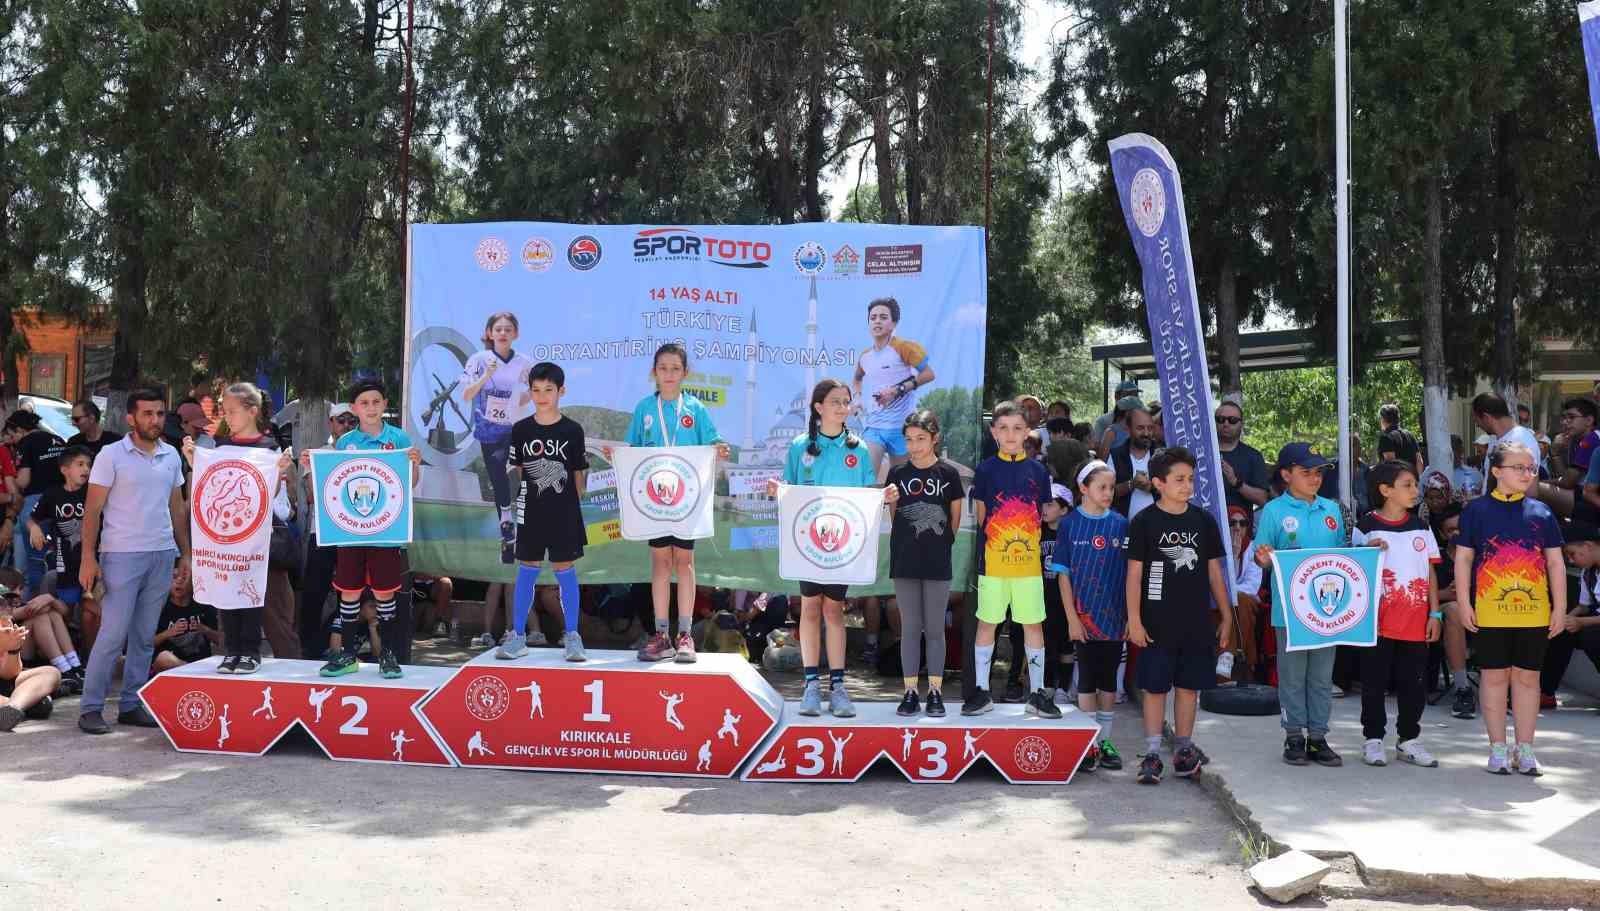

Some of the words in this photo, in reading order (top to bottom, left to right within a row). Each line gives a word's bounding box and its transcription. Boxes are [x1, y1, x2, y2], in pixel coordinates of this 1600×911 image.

[649, 288, 665, 300] 14
[671, 287, 700, 304] YAŞ
[704, 290, 738, 304] ALTI
[642, 309, 743, 334] TÜRKİYE
[695, 342, 856, 366] ŞAMPİYONASI
[492, 408, 506, 419] 26
[583, 679, 611, 723] 1
[339, 696, 369, 736] 2
[560, 730, 631, 744] KIRIKKALE
[504, 744, 552, 757] GENÇLİK
[554, 747, 568, 757] VE
[571, 747, 600, 758] SPOR
[602, 748, 611, 758] İL
[614, 749, 688, 761] MÜDÜRLÜĞÜ
[795, 737, 825, 776] 3
[918, 740, 948, 777] 3
